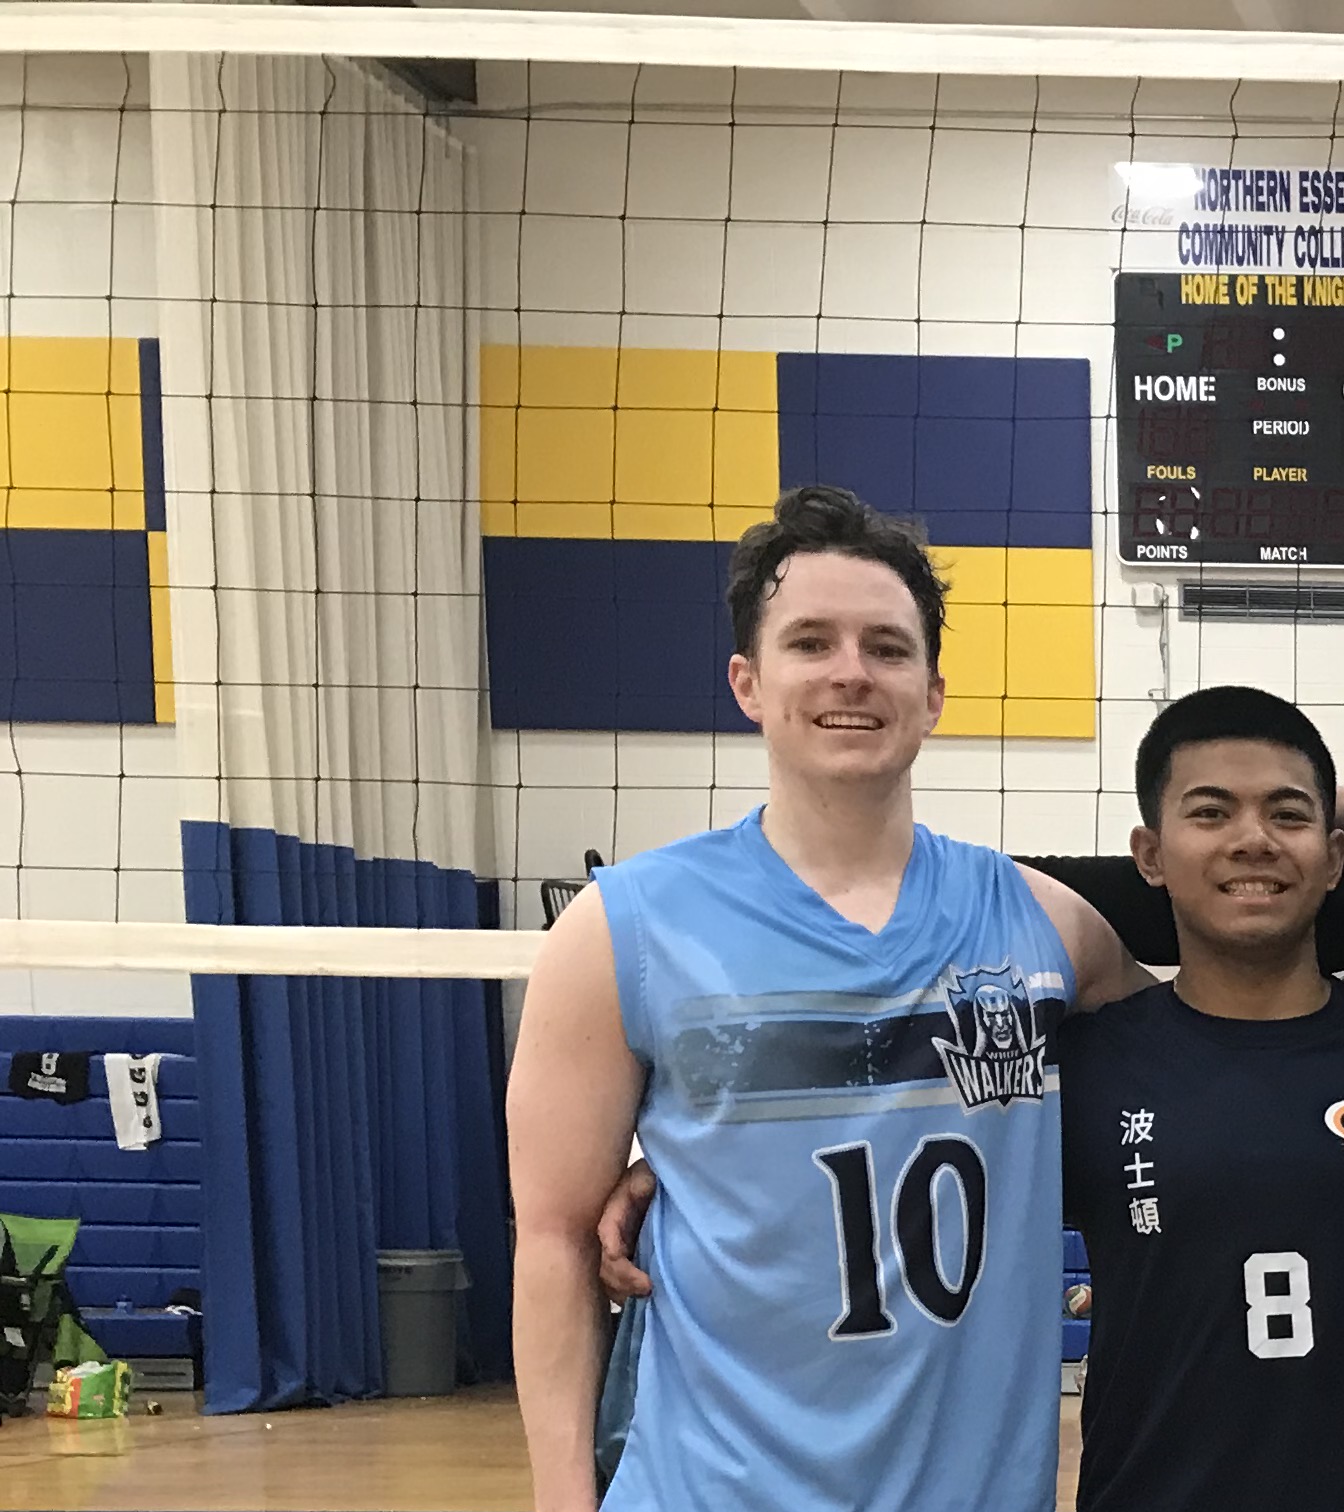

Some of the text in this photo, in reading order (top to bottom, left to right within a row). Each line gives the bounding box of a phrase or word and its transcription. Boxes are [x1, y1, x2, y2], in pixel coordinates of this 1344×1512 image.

[1194, 168, 1291, 212] NORTHERN
[1178, 221, 1286, 266] COMMUNITY
[1180, 274, 1230, 305] HOME
[1235, 275, 1259, 306] OF
[1264, 275, 1298, 306] THE
[1167, 334, 1183, 353] P
[1134, 375, 1216, 402] HOME
[1257, 377, 1306, 392] BONUS
[1252, 420, 1310, 436] PERIOD
[1147, 465, 1197, 480] FOULS
[1253, 467, 1308, 482] PLAYER
[1137, 545, 1188, 560] POINTS
[1260, 547, 1307, 562] MATCH
[948, 1045, 1046, 1106] WALKERS
[1119, 1107, 1162, 1235] 波士頓
[812, 1133, 988, 1342] 10
[1243, 1251, 1315, 1359] 8
